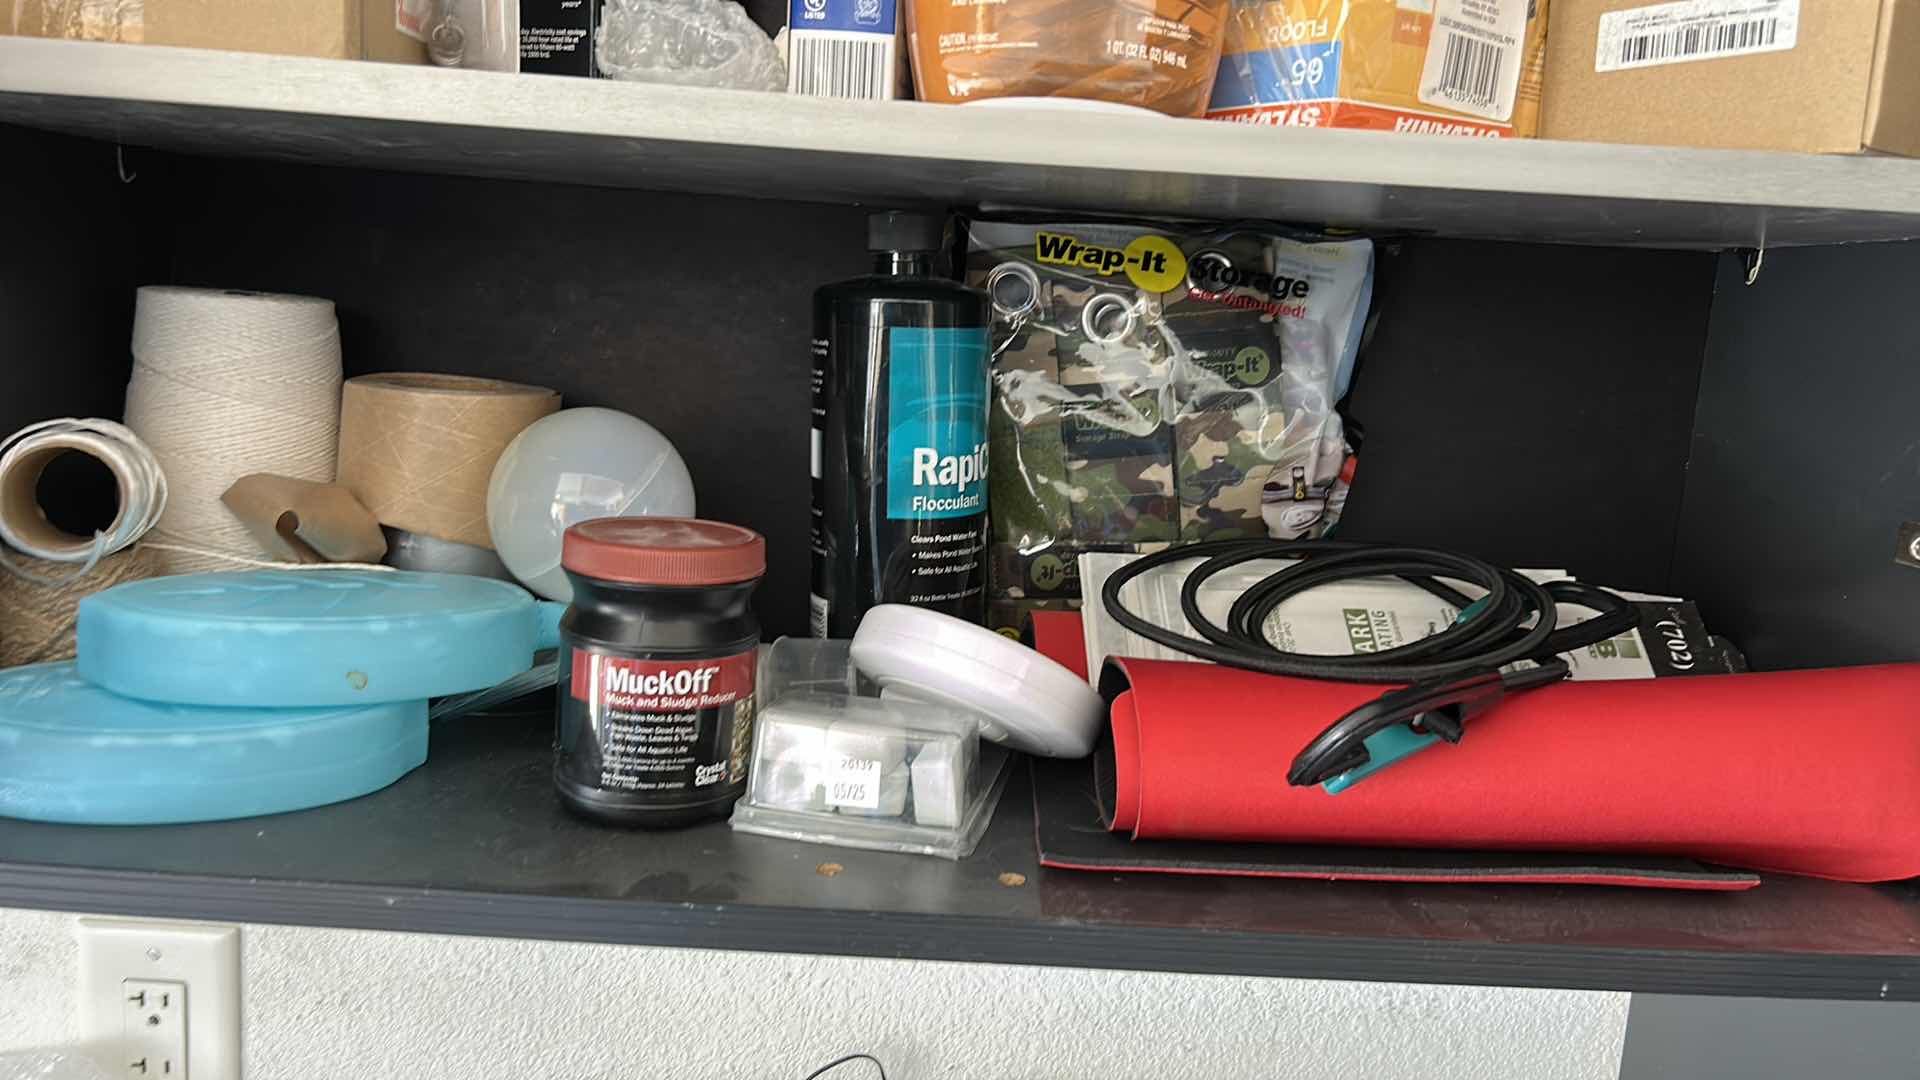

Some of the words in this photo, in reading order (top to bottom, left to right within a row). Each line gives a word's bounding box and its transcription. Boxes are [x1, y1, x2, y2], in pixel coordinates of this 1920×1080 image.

[1291, 56, 1325, 86] 65
[1038, 233, 1168, 275] Wrap-It
[912, 493, 980, 512] Flocculant
[934, 534, 952, 544] Pond
[1655, 620, 1695, 670] (702)
[606, 692, 635, 707] Muck
[636, 696, 659, 708] and
[660, 695, 698, 710] Sludge
[700, 690, 737, 706] Reducer
[695, 760, 727, 777] Crystal
